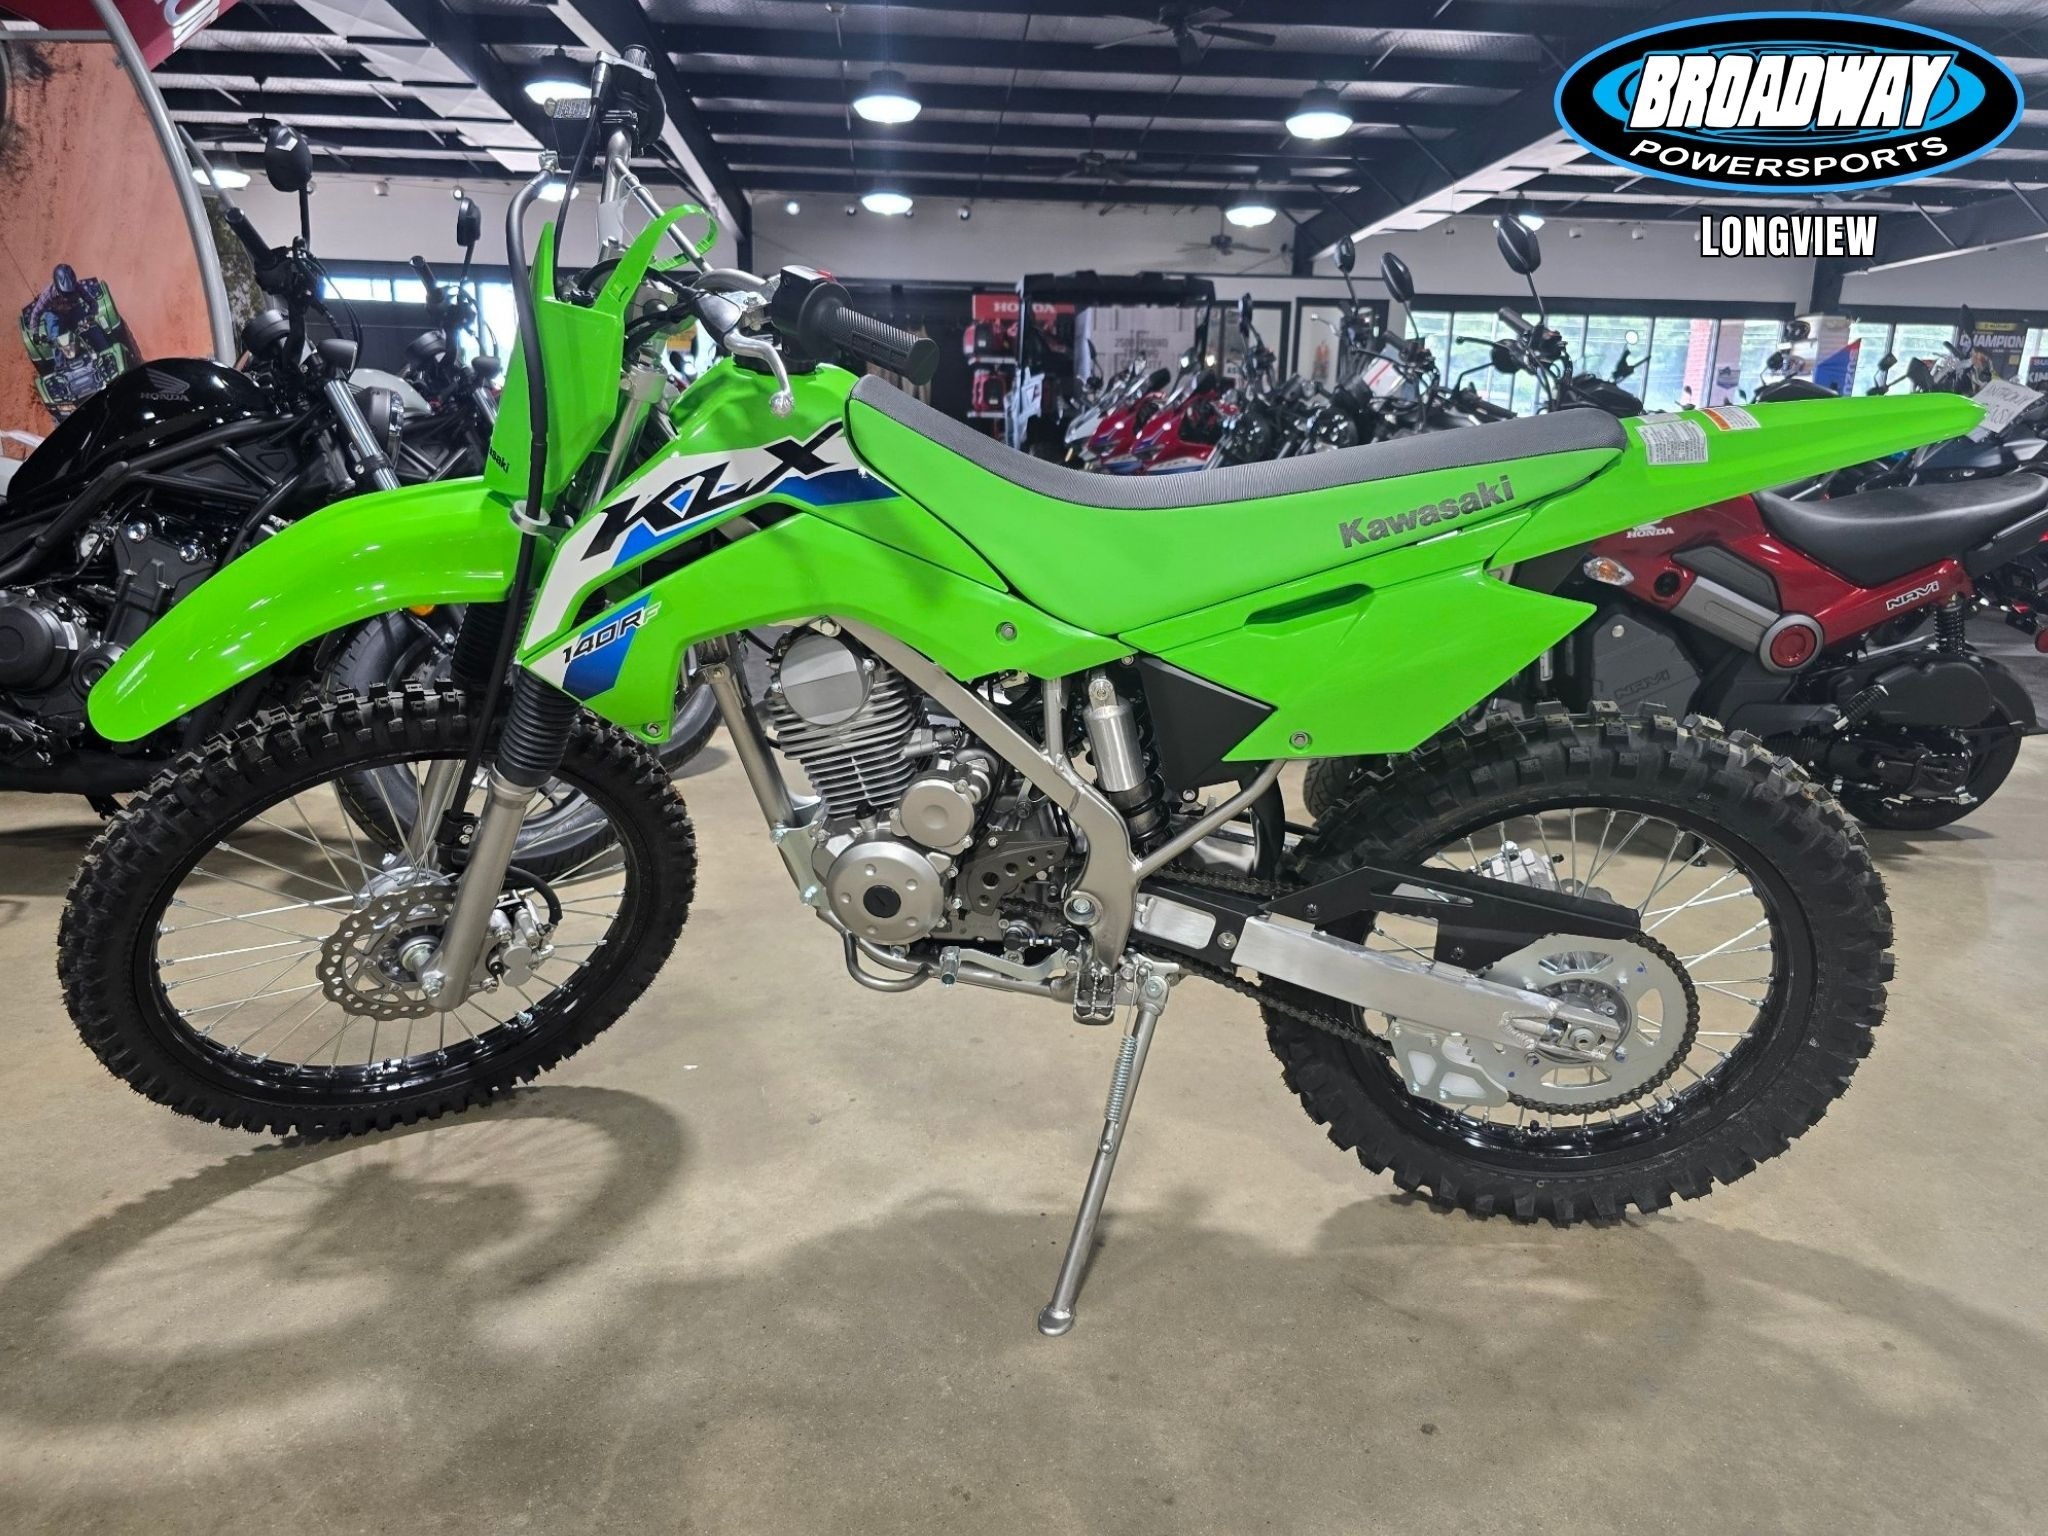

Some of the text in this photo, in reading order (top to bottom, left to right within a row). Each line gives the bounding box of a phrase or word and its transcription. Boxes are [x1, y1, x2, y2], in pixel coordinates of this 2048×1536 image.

[994, 301, 1056, 313] HODA
[140, 392, 191, 402] HONDA
[580, 420, 845, 562] KLX
[1338, 474, 1515, 549] Kawasaki
[1626, 526, 1675, 539] HONDA
